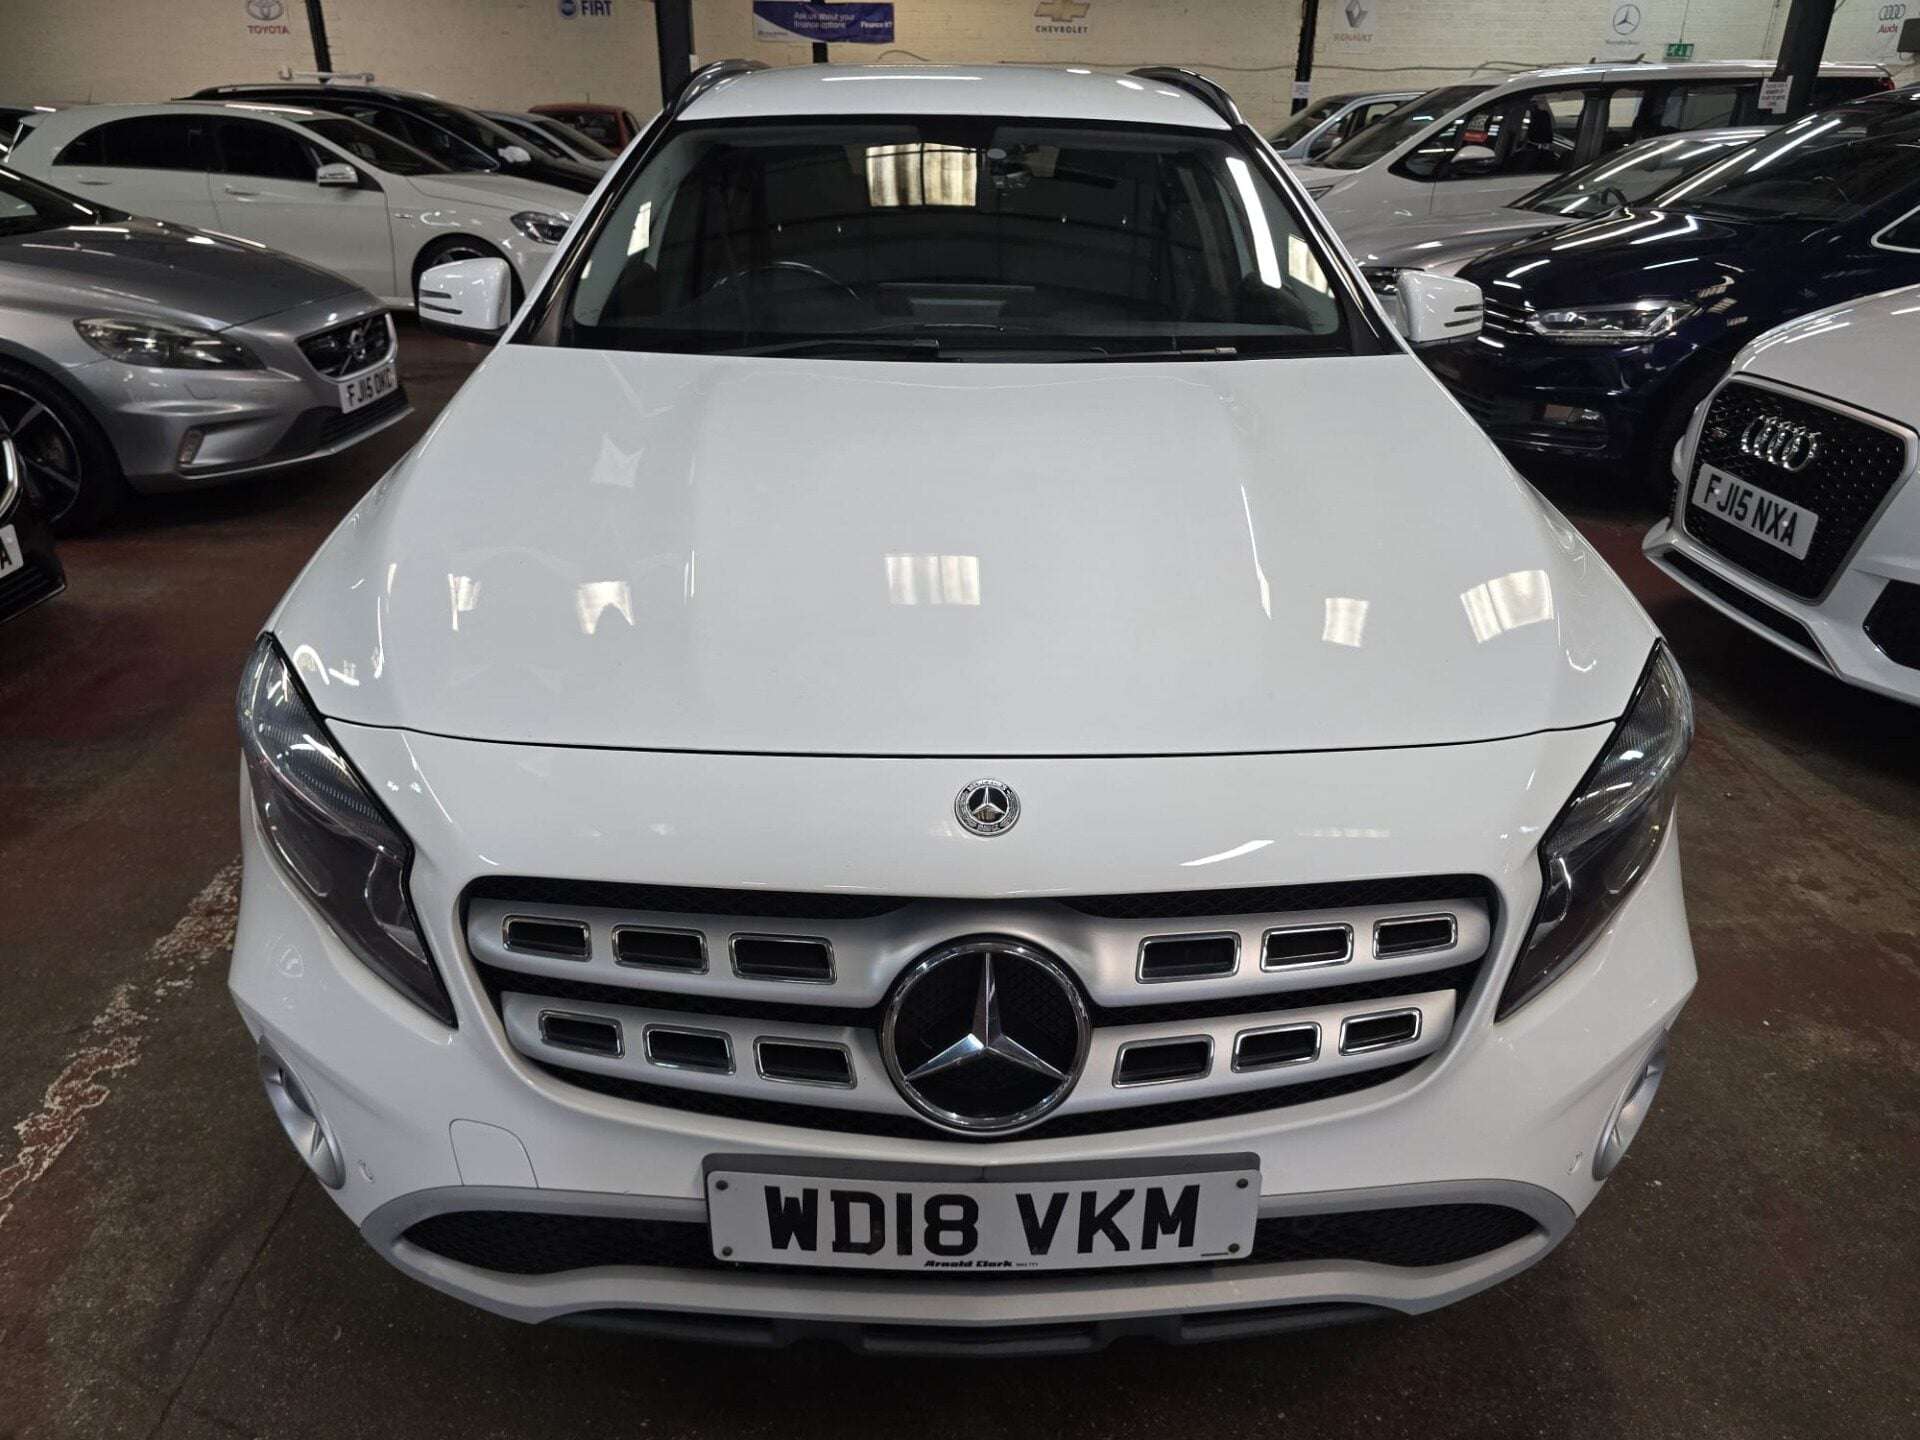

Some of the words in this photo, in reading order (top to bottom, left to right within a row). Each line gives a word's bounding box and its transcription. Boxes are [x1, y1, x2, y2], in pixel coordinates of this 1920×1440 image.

[581, 0, 612, 16] FIAT
[247, 25, 290, 34] TOYOTA
[1035, 25, 1088, 33] CHEVROLET
[347, 376, 374, 407] FJ15
[1703, 473, 1752, 521] FJ15
[1752, 499, 1798, 547] NXA
[764, 1185, 979, 1256] WD18
[1015, 1184, 1200, 1255] VKM
[924, 1260, 973, 1268] Arnold
[976, 1260, 1013, 1268] Clark
